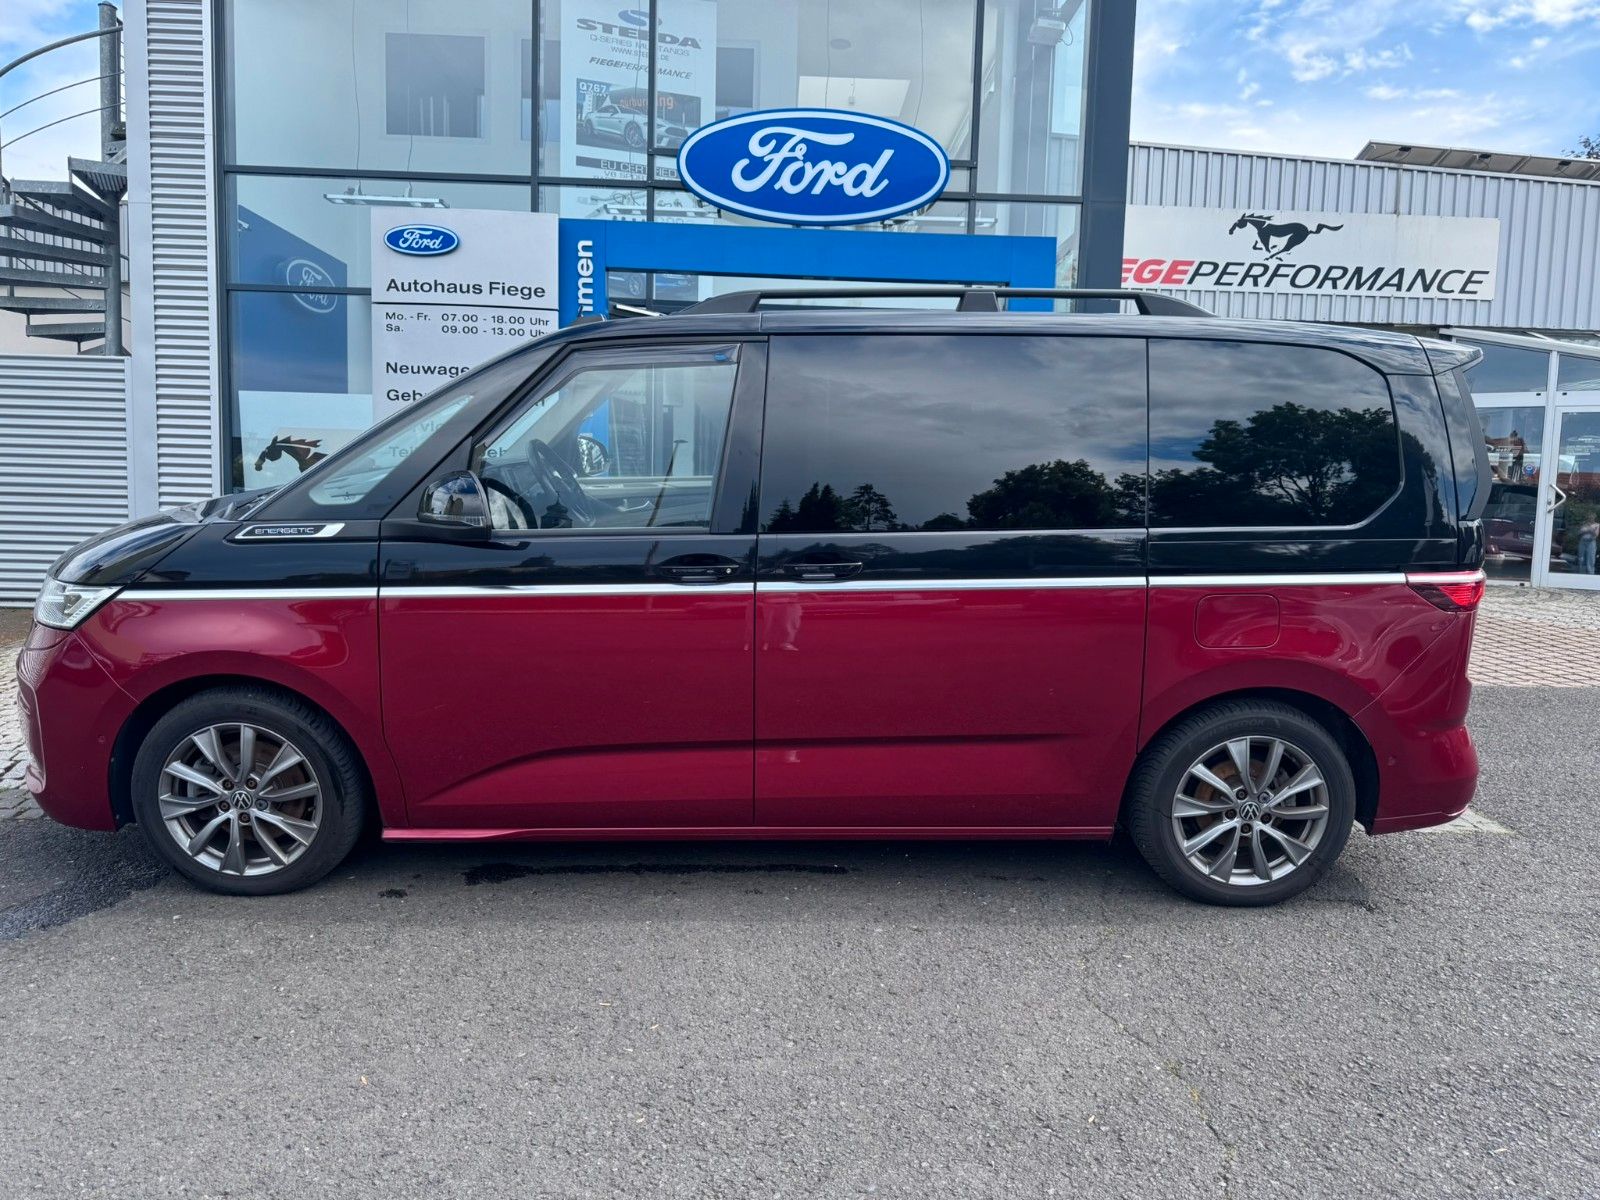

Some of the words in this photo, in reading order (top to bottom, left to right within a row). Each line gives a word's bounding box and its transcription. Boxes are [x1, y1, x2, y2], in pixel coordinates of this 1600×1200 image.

[731, 127, 894, 198] Ford
[398, 228, 442, 249] Ford
[1121, 258, 1490, 295] EGEPERFORMANCE
[386, 278, 483, 295] Autohaus
[489, 281, 546, 300] Fiege
[385, 312, 407, 321] Mo.
[417, 313, 431, 321] Fr.
[441, 313, 478, 323] 07.00
[491, 315, 525, 325] 18.00
[529, 317, 550, 326] Uhr
[385, 324, 404, 332] Sa.
[441, 325, 478, 335] 09.00
[491, 327, 525, 337] 13.00
[529, 328, 548, 337] Uh
[255, 527, 314, 535] ENERGETIC
